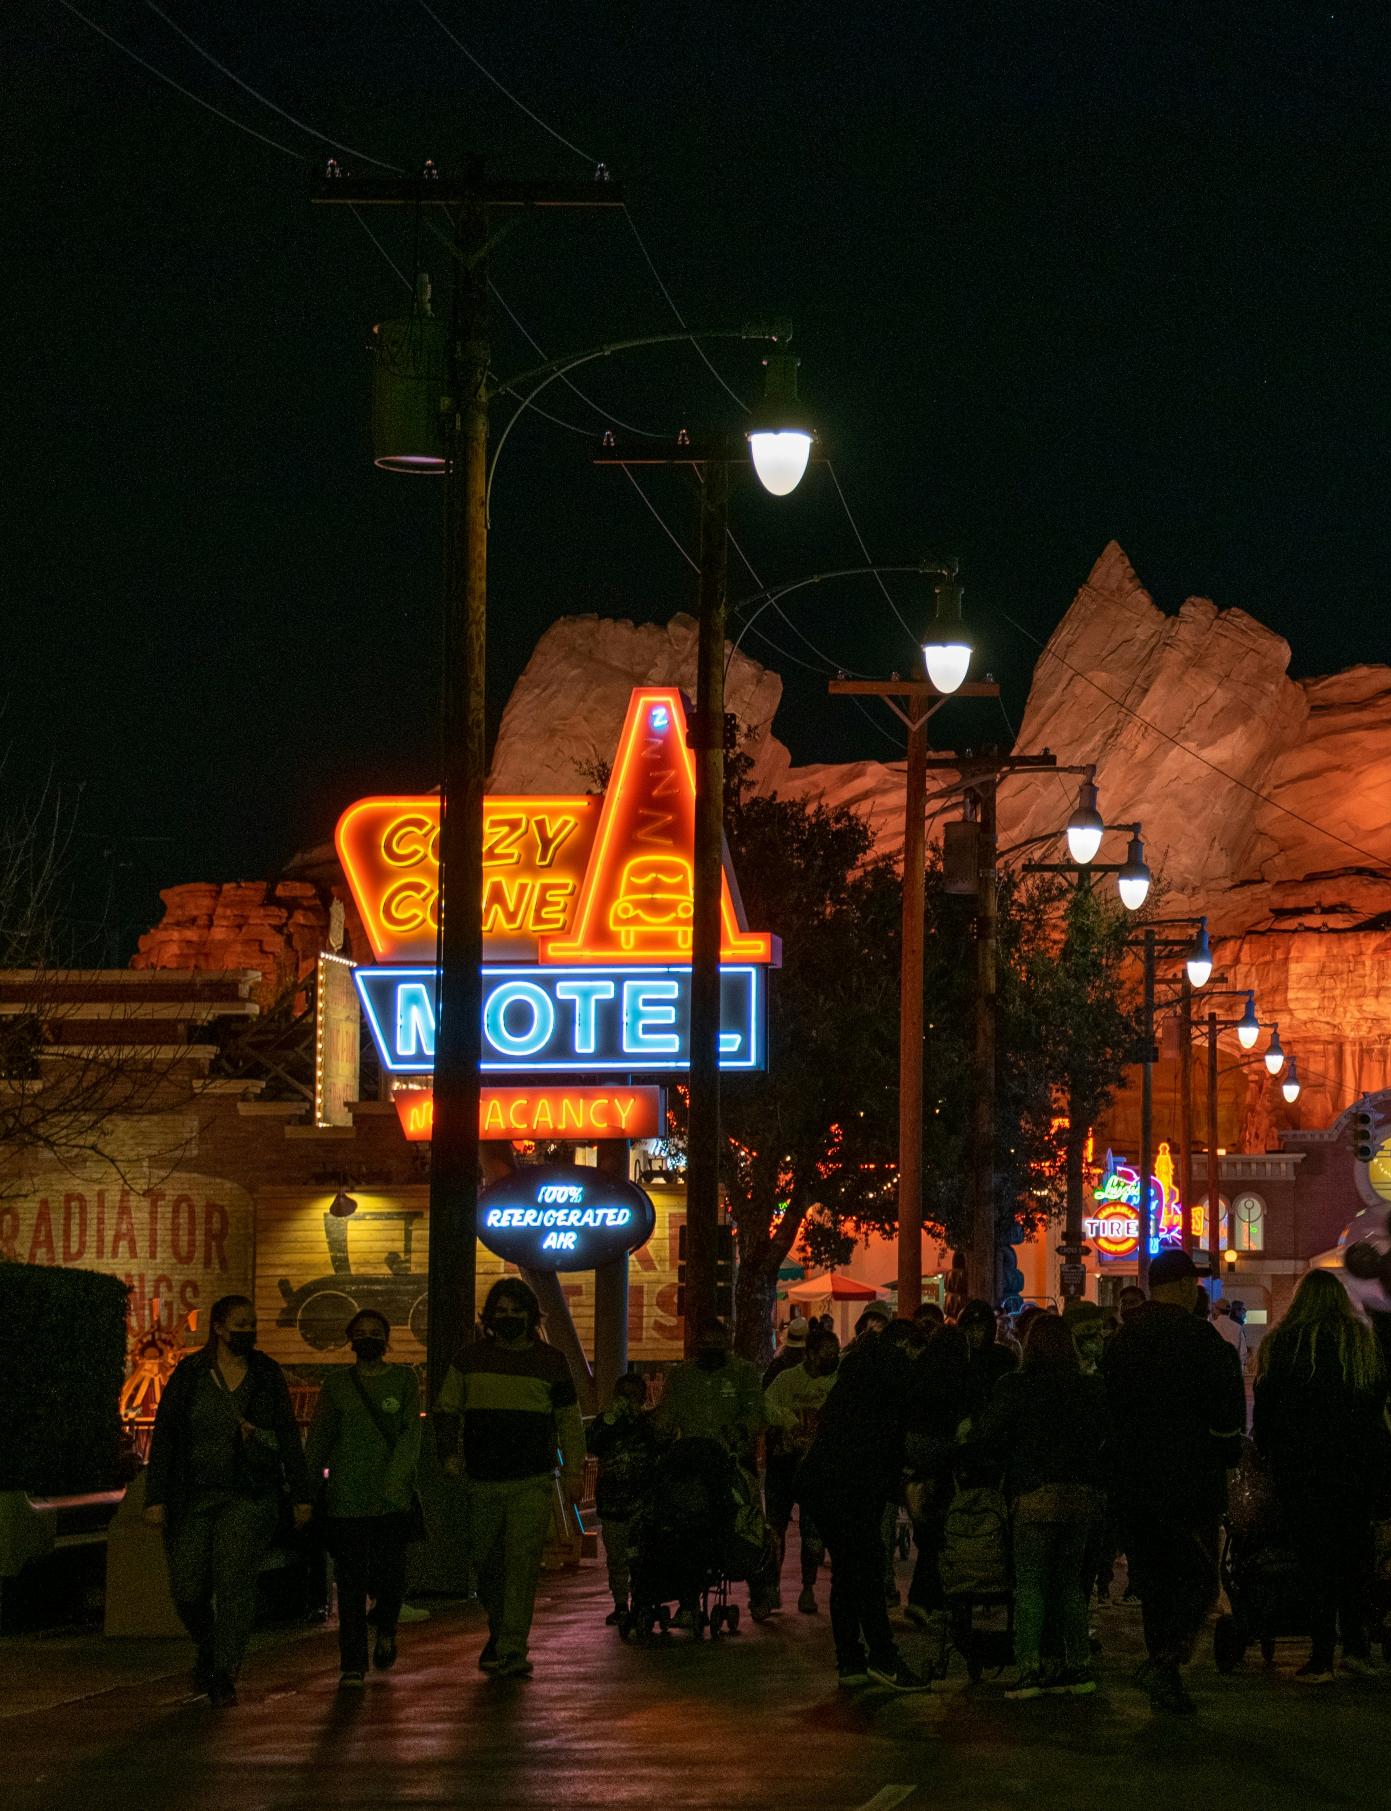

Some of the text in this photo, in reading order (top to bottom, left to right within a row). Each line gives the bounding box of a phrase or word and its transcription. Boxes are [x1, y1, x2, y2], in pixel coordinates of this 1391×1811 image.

[381, 814, 577, 867] CZY
[380, 877, 575, 933] CNE
[397, 980, 742, 1057] MOTE
[409, 1098, 637, 1132] N ACANCY
[538, 1185, 585, 1204] 100%
[0, 1189, 229, 1272] RADIATOR
[543, 1231, 579, 1251] AIR
